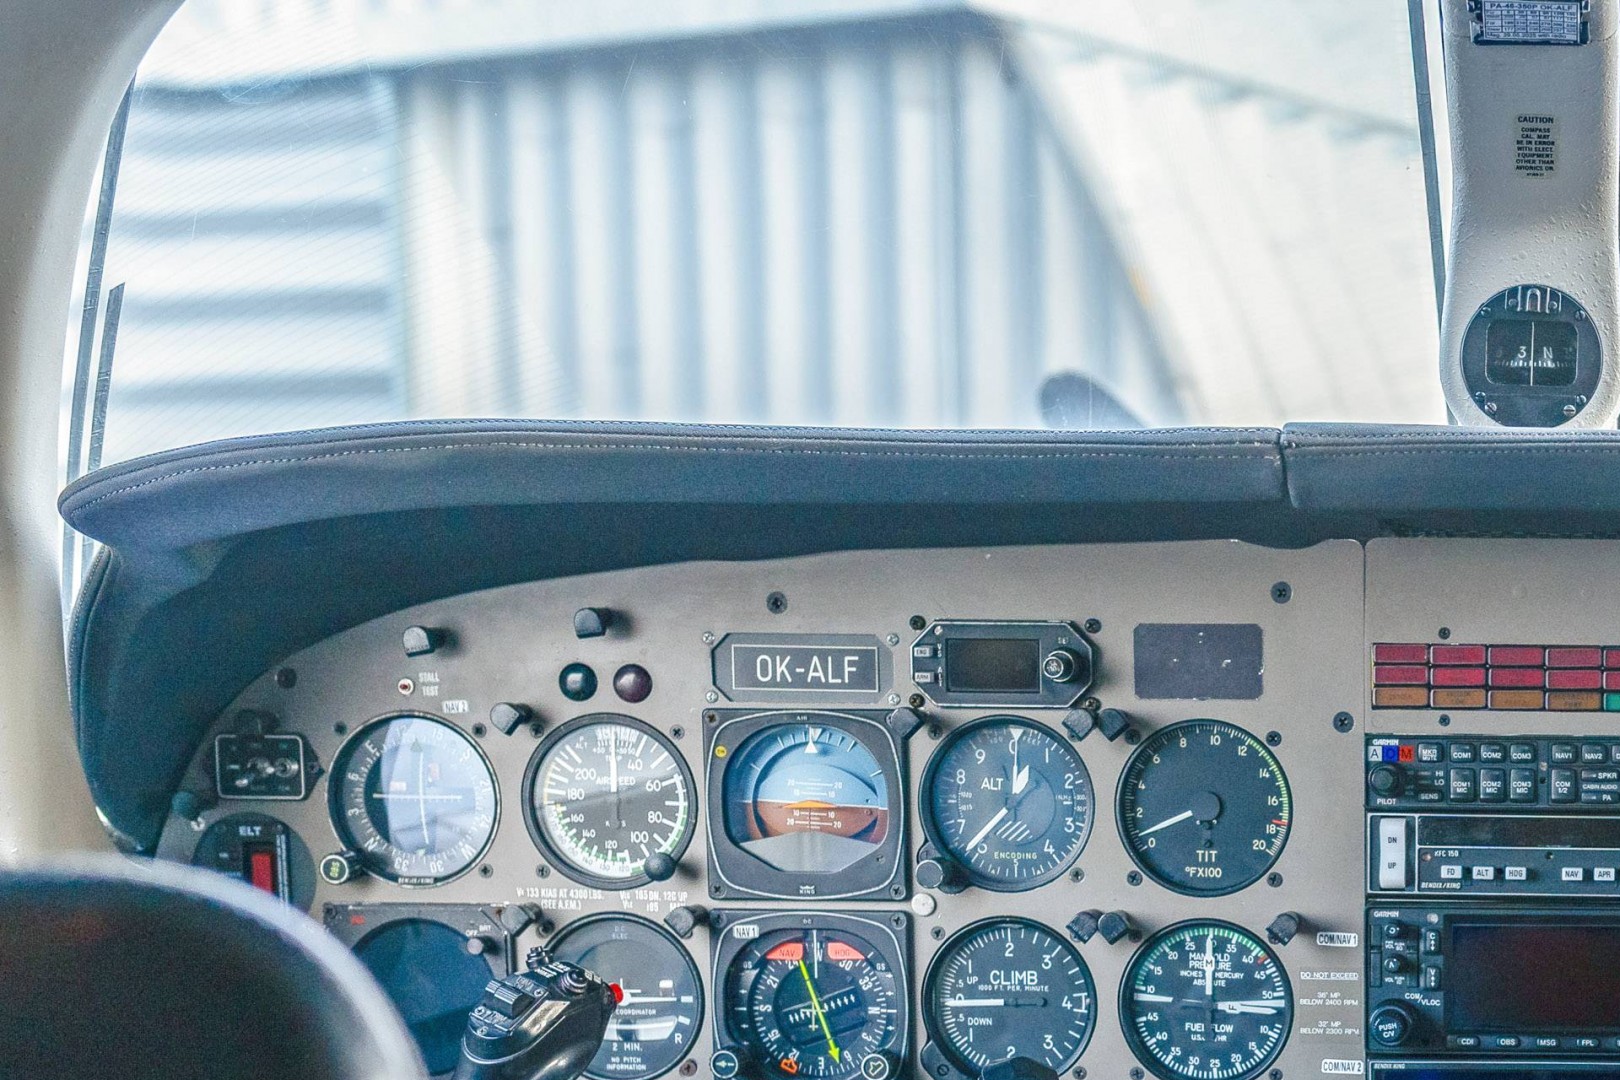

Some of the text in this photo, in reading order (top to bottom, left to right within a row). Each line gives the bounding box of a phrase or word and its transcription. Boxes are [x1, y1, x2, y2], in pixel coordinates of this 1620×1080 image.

[1517, 116, 1554, 124] CAUTION
[1517, 346, 1527, 358] 3
[1543, 346, 1553, 358] N
[754, 654, 860, 684] OK-ALF
[980, 778, 1003, 790] ALT
[238, 826, 262, 836] ELT
[1196, 850, 1218, 864] TIT
[1446, 868, 1456, 876] FD
[1476, 869, 1489, 877] ALT
[1509, 870, 1523, 878] HDG
[1565, 870, 1579, 878] NAV
[1598, 870, 1611, 878] APR
[735, 927, 757, 936] NAV 1
[1318, 933, 1357, 945] COM/NAV 1
[989, 970, 1038, 985] CLIMB
[1301, 971, 1359, 979] DO NOT EXCEED
[966, 976, 979, 985] UP
[967, 1017, 993, 1026] DOWN
[1461, 1038, 1474, 1046] CDI
[1500, 1038, 1516, 1046] OBS
[1323, 1061, 1362, 1073] COM/NAV 2
